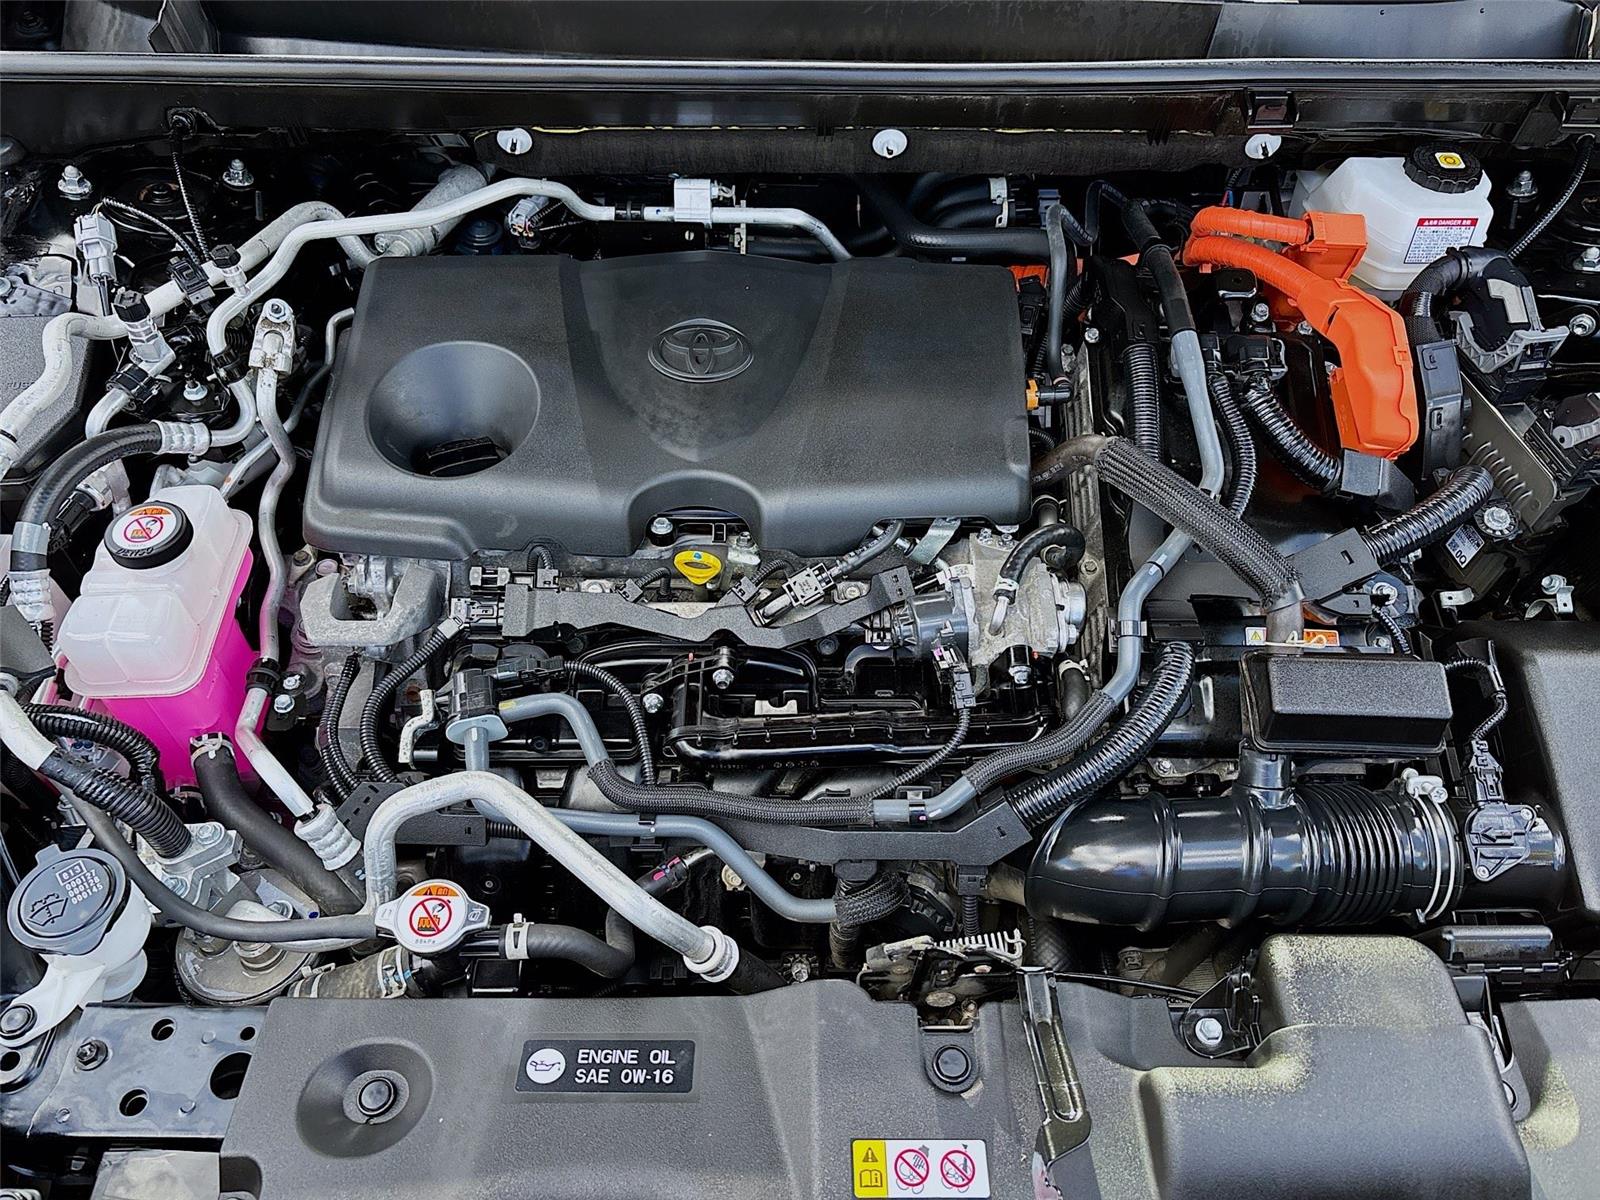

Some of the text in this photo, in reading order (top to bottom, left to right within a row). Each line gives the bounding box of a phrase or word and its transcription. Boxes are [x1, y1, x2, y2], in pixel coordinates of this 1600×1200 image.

[6, 382, 35, 390] FUS
[115, 547, 154, 557] DENSO
[65, 869, 96, 890] 000127
[68, 877, 100, 898] 000128
[71, 884, 104, 905] 000145
[577, 1049, 676, 1064] ENGINE OIL
[574, 1069, 674, 1084] SAE 0W-16
